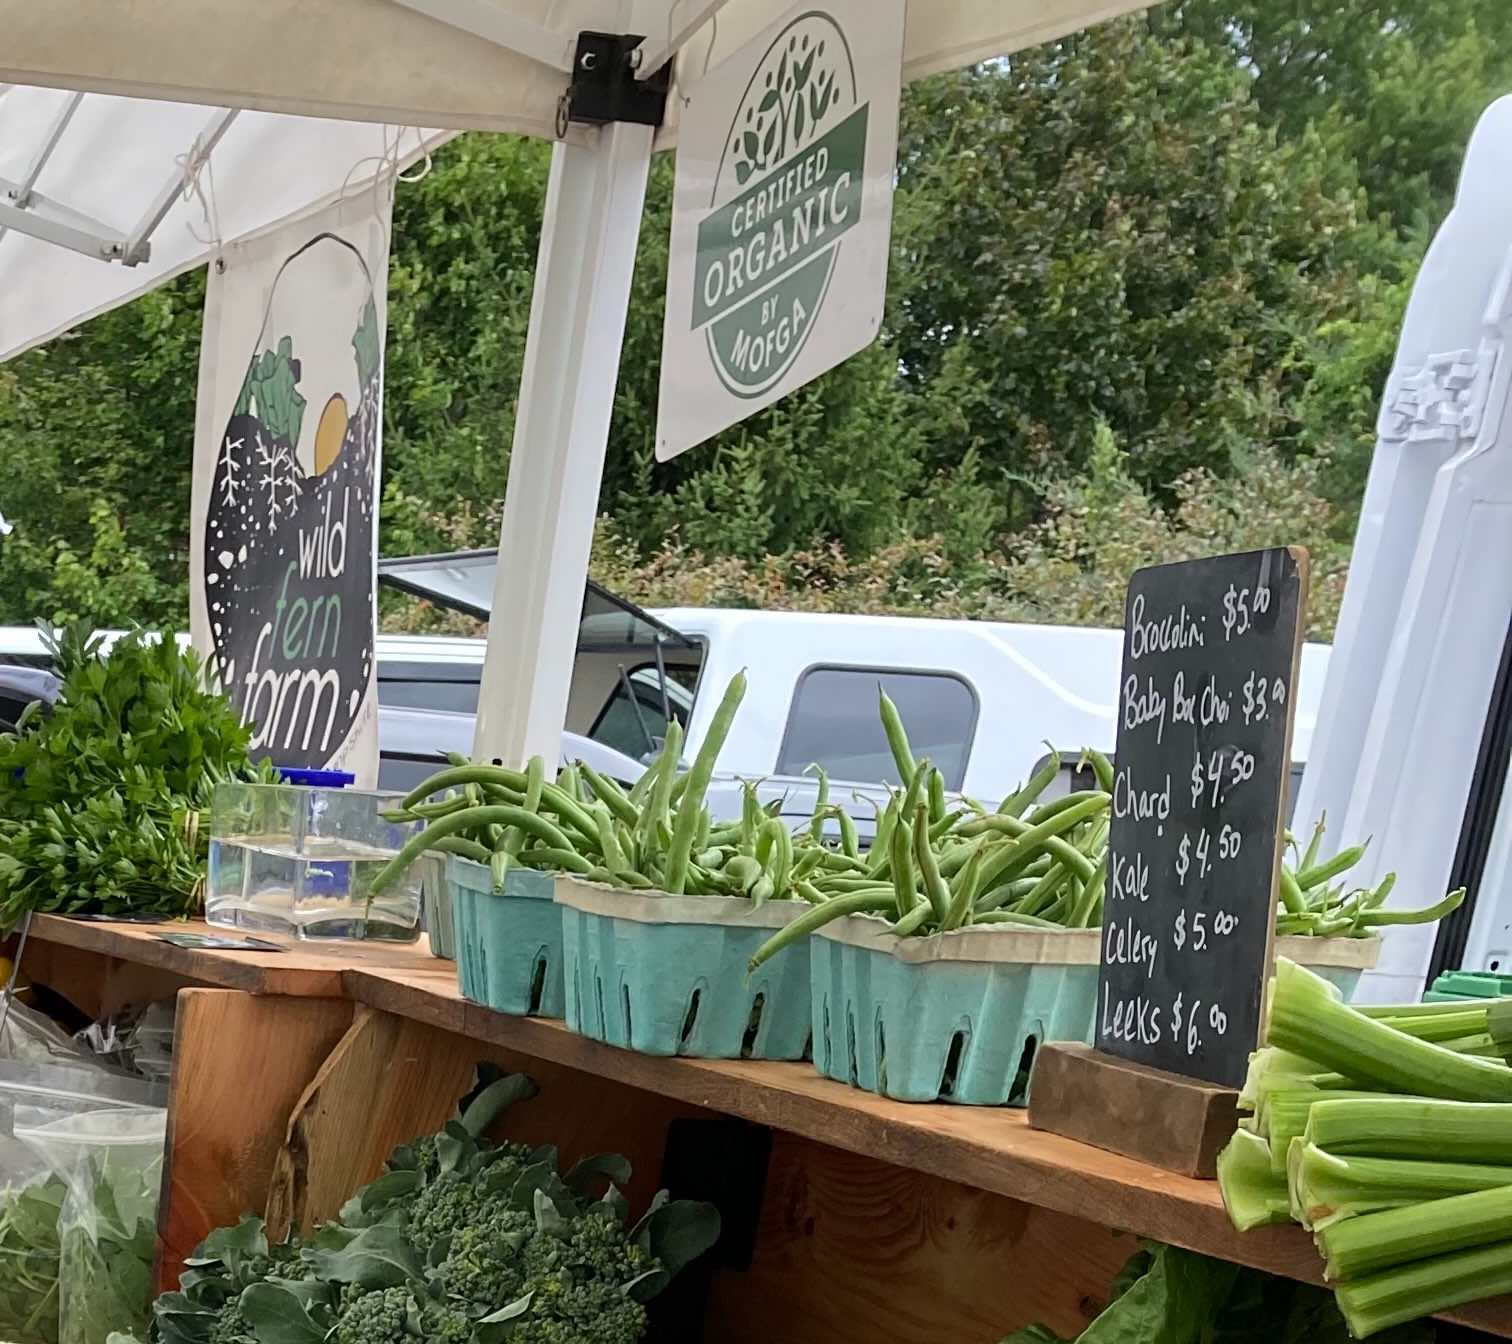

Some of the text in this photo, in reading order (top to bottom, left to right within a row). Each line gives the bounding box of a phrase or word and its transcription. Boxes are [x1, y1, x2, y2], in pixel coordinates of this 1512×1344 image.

[732, 147, 829, 237] CERTIFIED
[704, 172, 850, 307] ORGANIC
[730, 297, 806, 372] MOFGA
[762, 294, 779, 325] BY
[299, 487, 350, 579] wild
[269, 561, 342, 660] fern
[240, 622, 341, 751] farm
[1123, 673, 1167, 745] Baby
[1200, 674, 1233, 727] Choi
[1113, 766, 1171, 822] Chard
[1112, 852, 1150, 902] Kale
[1105, 916, 1158, 979] Celery
